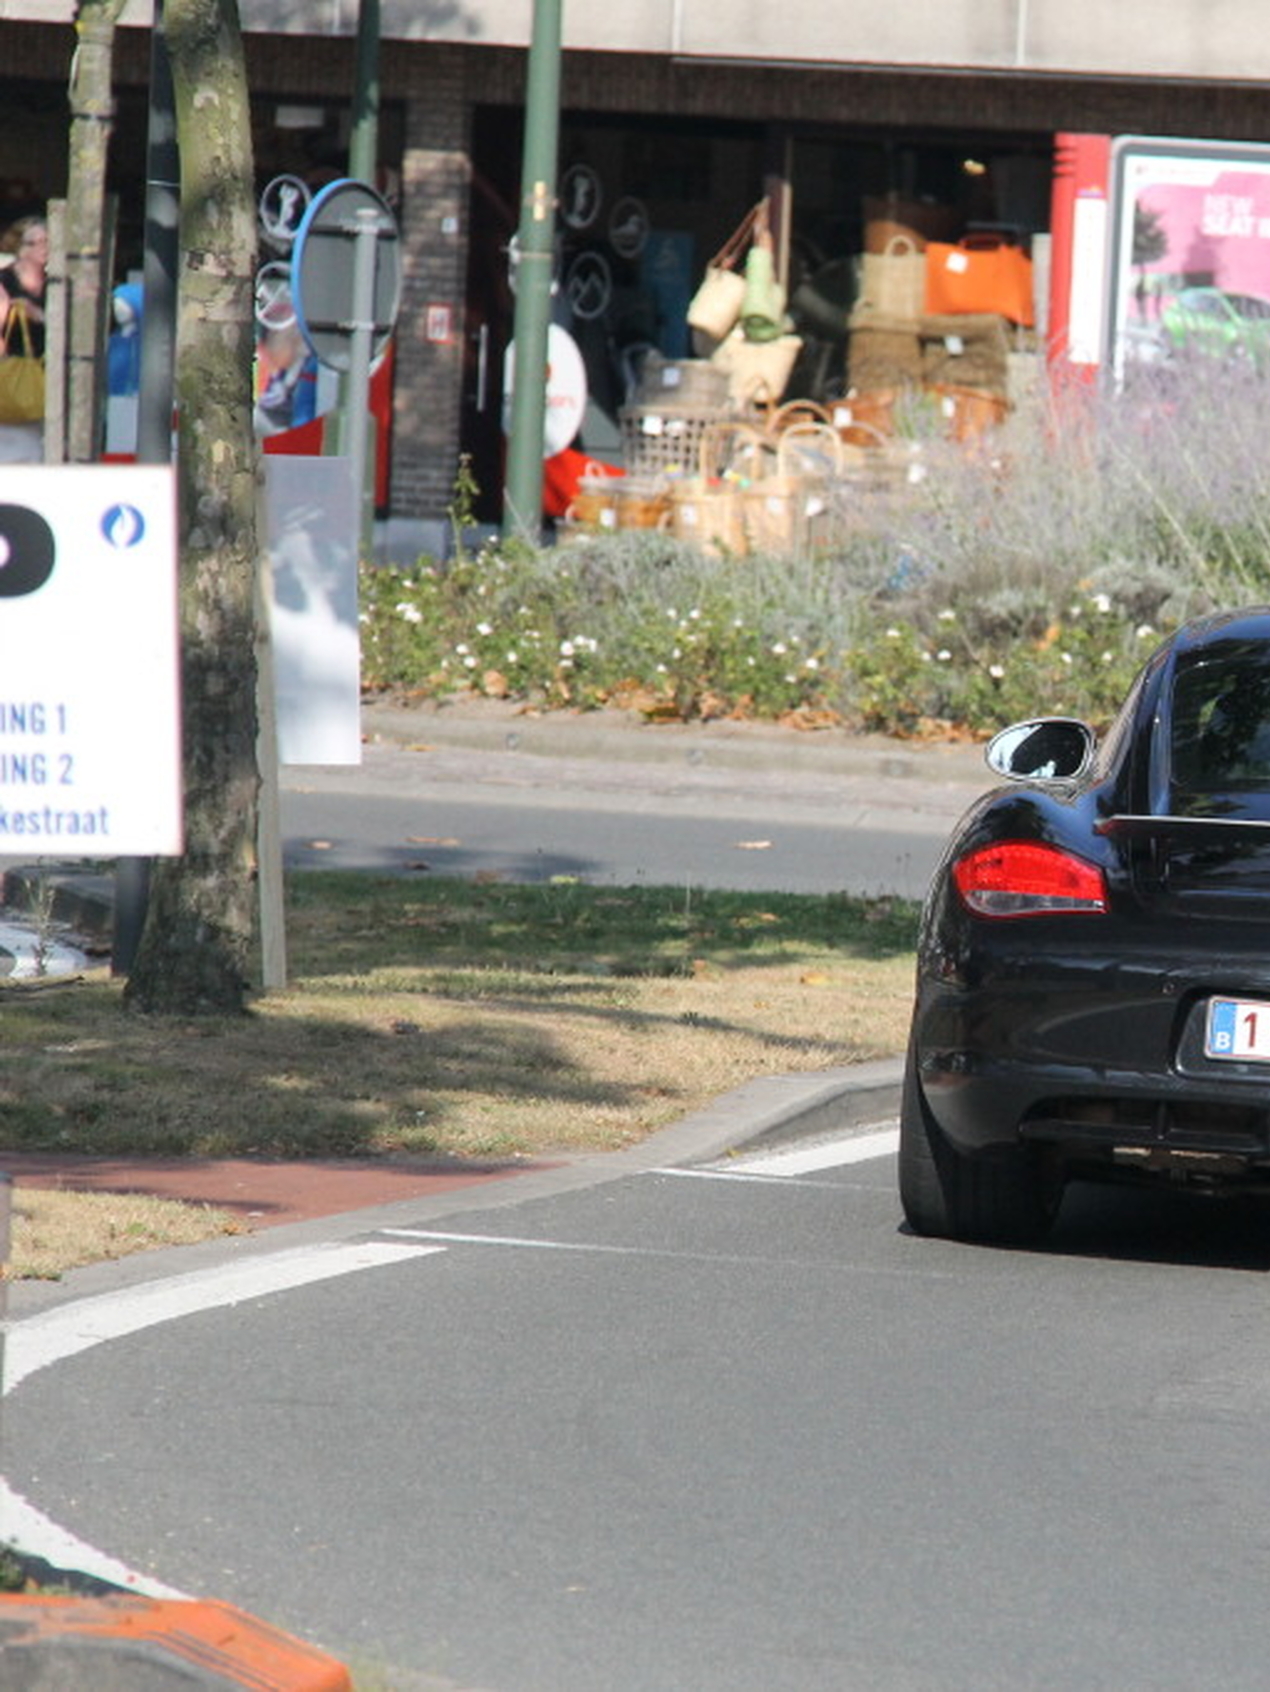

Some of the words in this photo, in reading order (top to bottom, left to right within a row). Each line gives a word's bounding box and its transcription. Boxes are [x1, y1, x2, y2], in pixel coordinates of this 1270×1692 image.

[1203, 194, 1254, 219] NEW
[1202, 215, 1253, 238] SEAT
[56, 702, 66, 735] 1
[59, 752, 74, 785] 2
[1214, 1032, 1231, 1051] B
